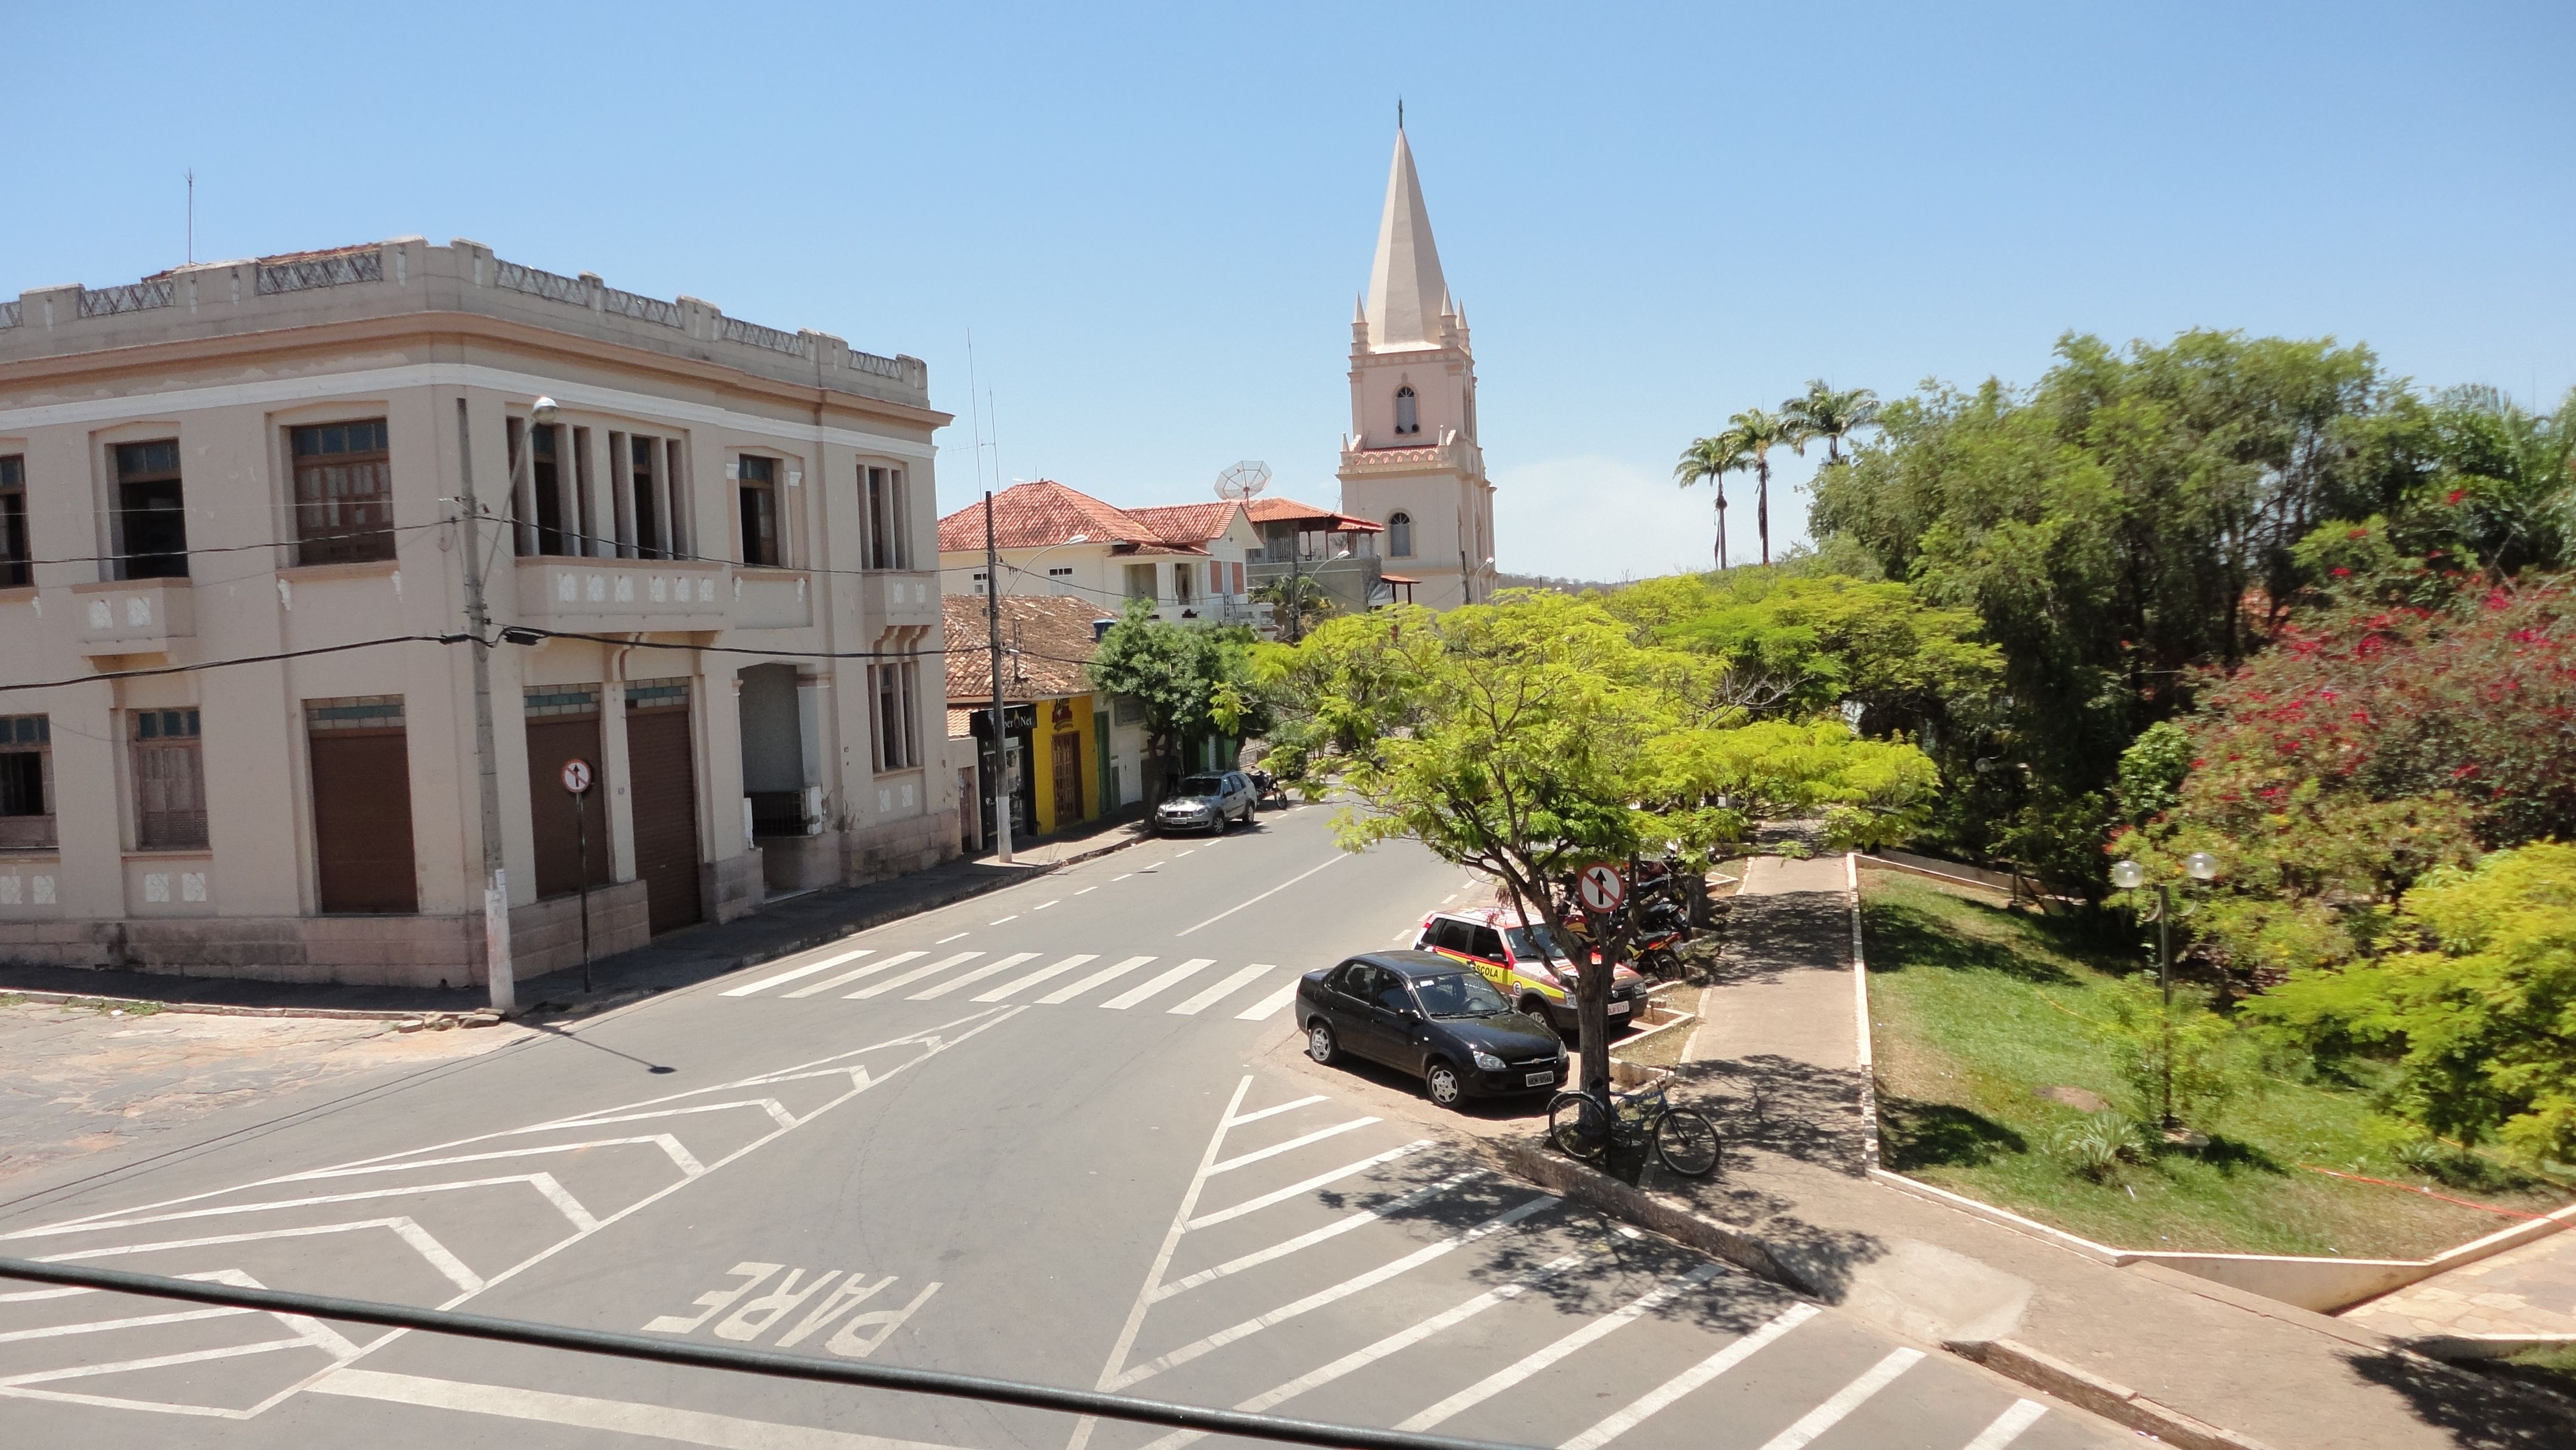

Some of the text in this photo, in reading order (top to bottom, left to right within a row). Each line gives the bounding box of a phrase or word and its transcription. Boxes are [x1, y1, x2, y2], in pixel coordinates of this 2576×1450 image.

[1020, 716, 1032, 727] Net
[1474, 964, 1498, 978] SCOLA
[640, 1262, 944, 1358] PARE
